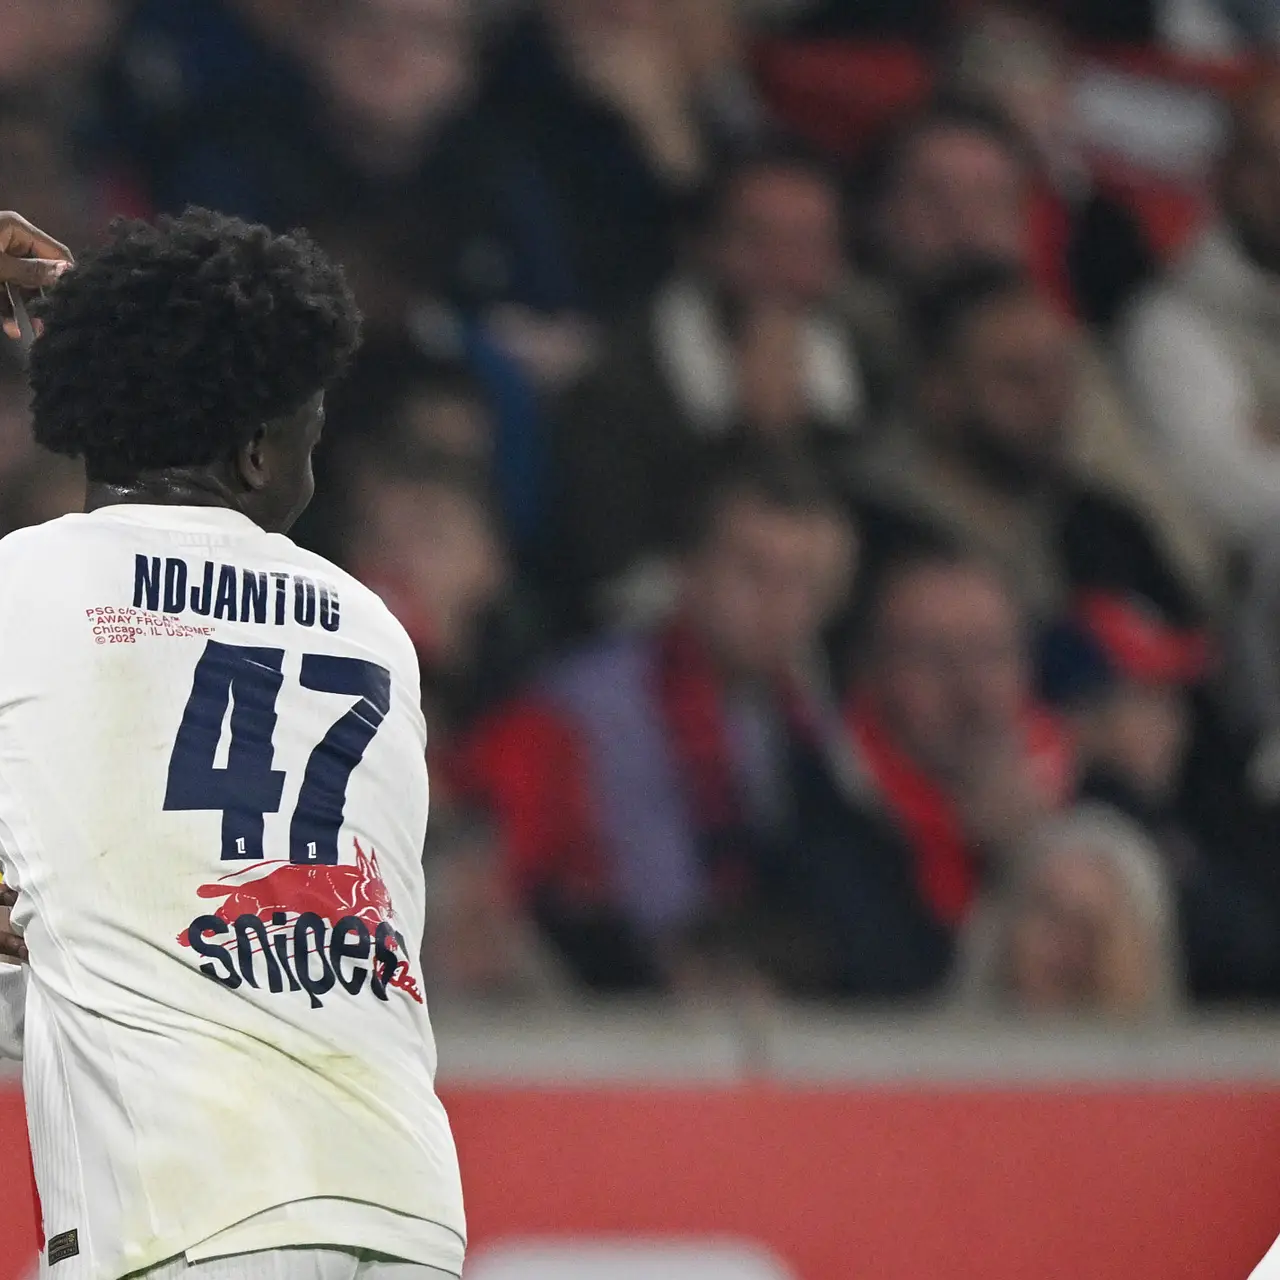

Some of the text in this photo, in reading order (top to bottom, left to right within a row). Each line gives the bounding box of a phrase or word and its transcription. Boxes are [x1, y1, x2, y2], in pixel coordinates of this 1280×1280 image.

[85, 606, 115, 617] PSG
[118, 607, 137, 616] c/o
[108, 635, 136, 644] 2025
[162, 639, 391, 865] 47
